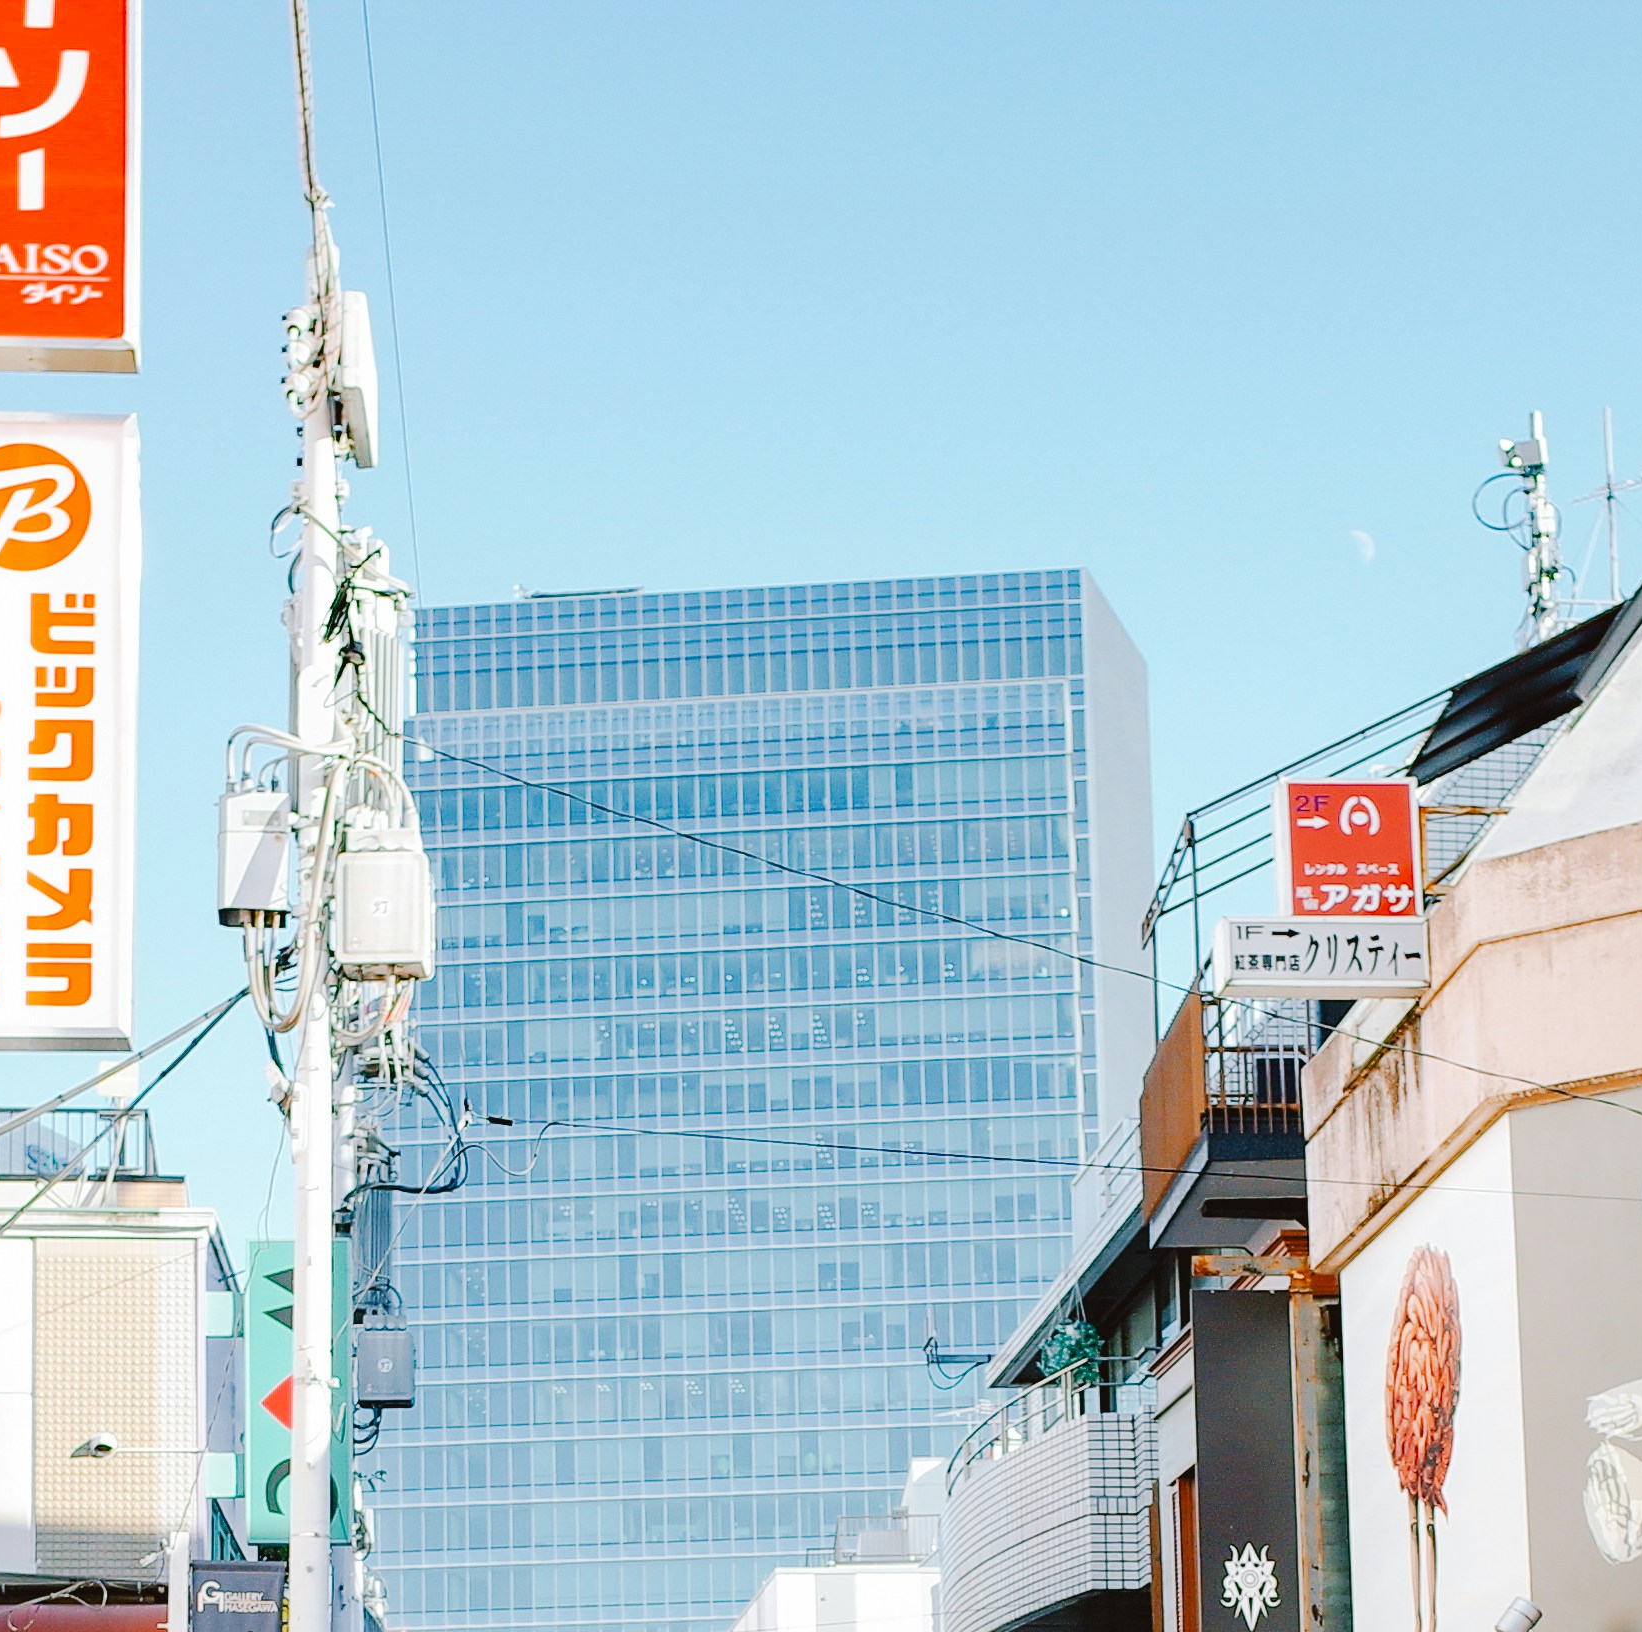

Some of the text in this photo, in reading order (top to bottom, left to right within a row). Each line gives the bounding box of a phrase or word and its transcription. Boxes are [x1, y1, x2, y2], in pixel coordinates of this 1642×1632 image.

[21, 281, 103, 305] ダイソー
[25, 593, 96, 1007] ビックカメラ
[1295, 794, 1330, 812] 2F
[1304, 862, 1401, 876] レンタル スペース
[1319, 882, 1415, 913] アガサ
[1235, 925, 1265, 940] 1F
[1304, 933, 1422, 977] クリスティー
